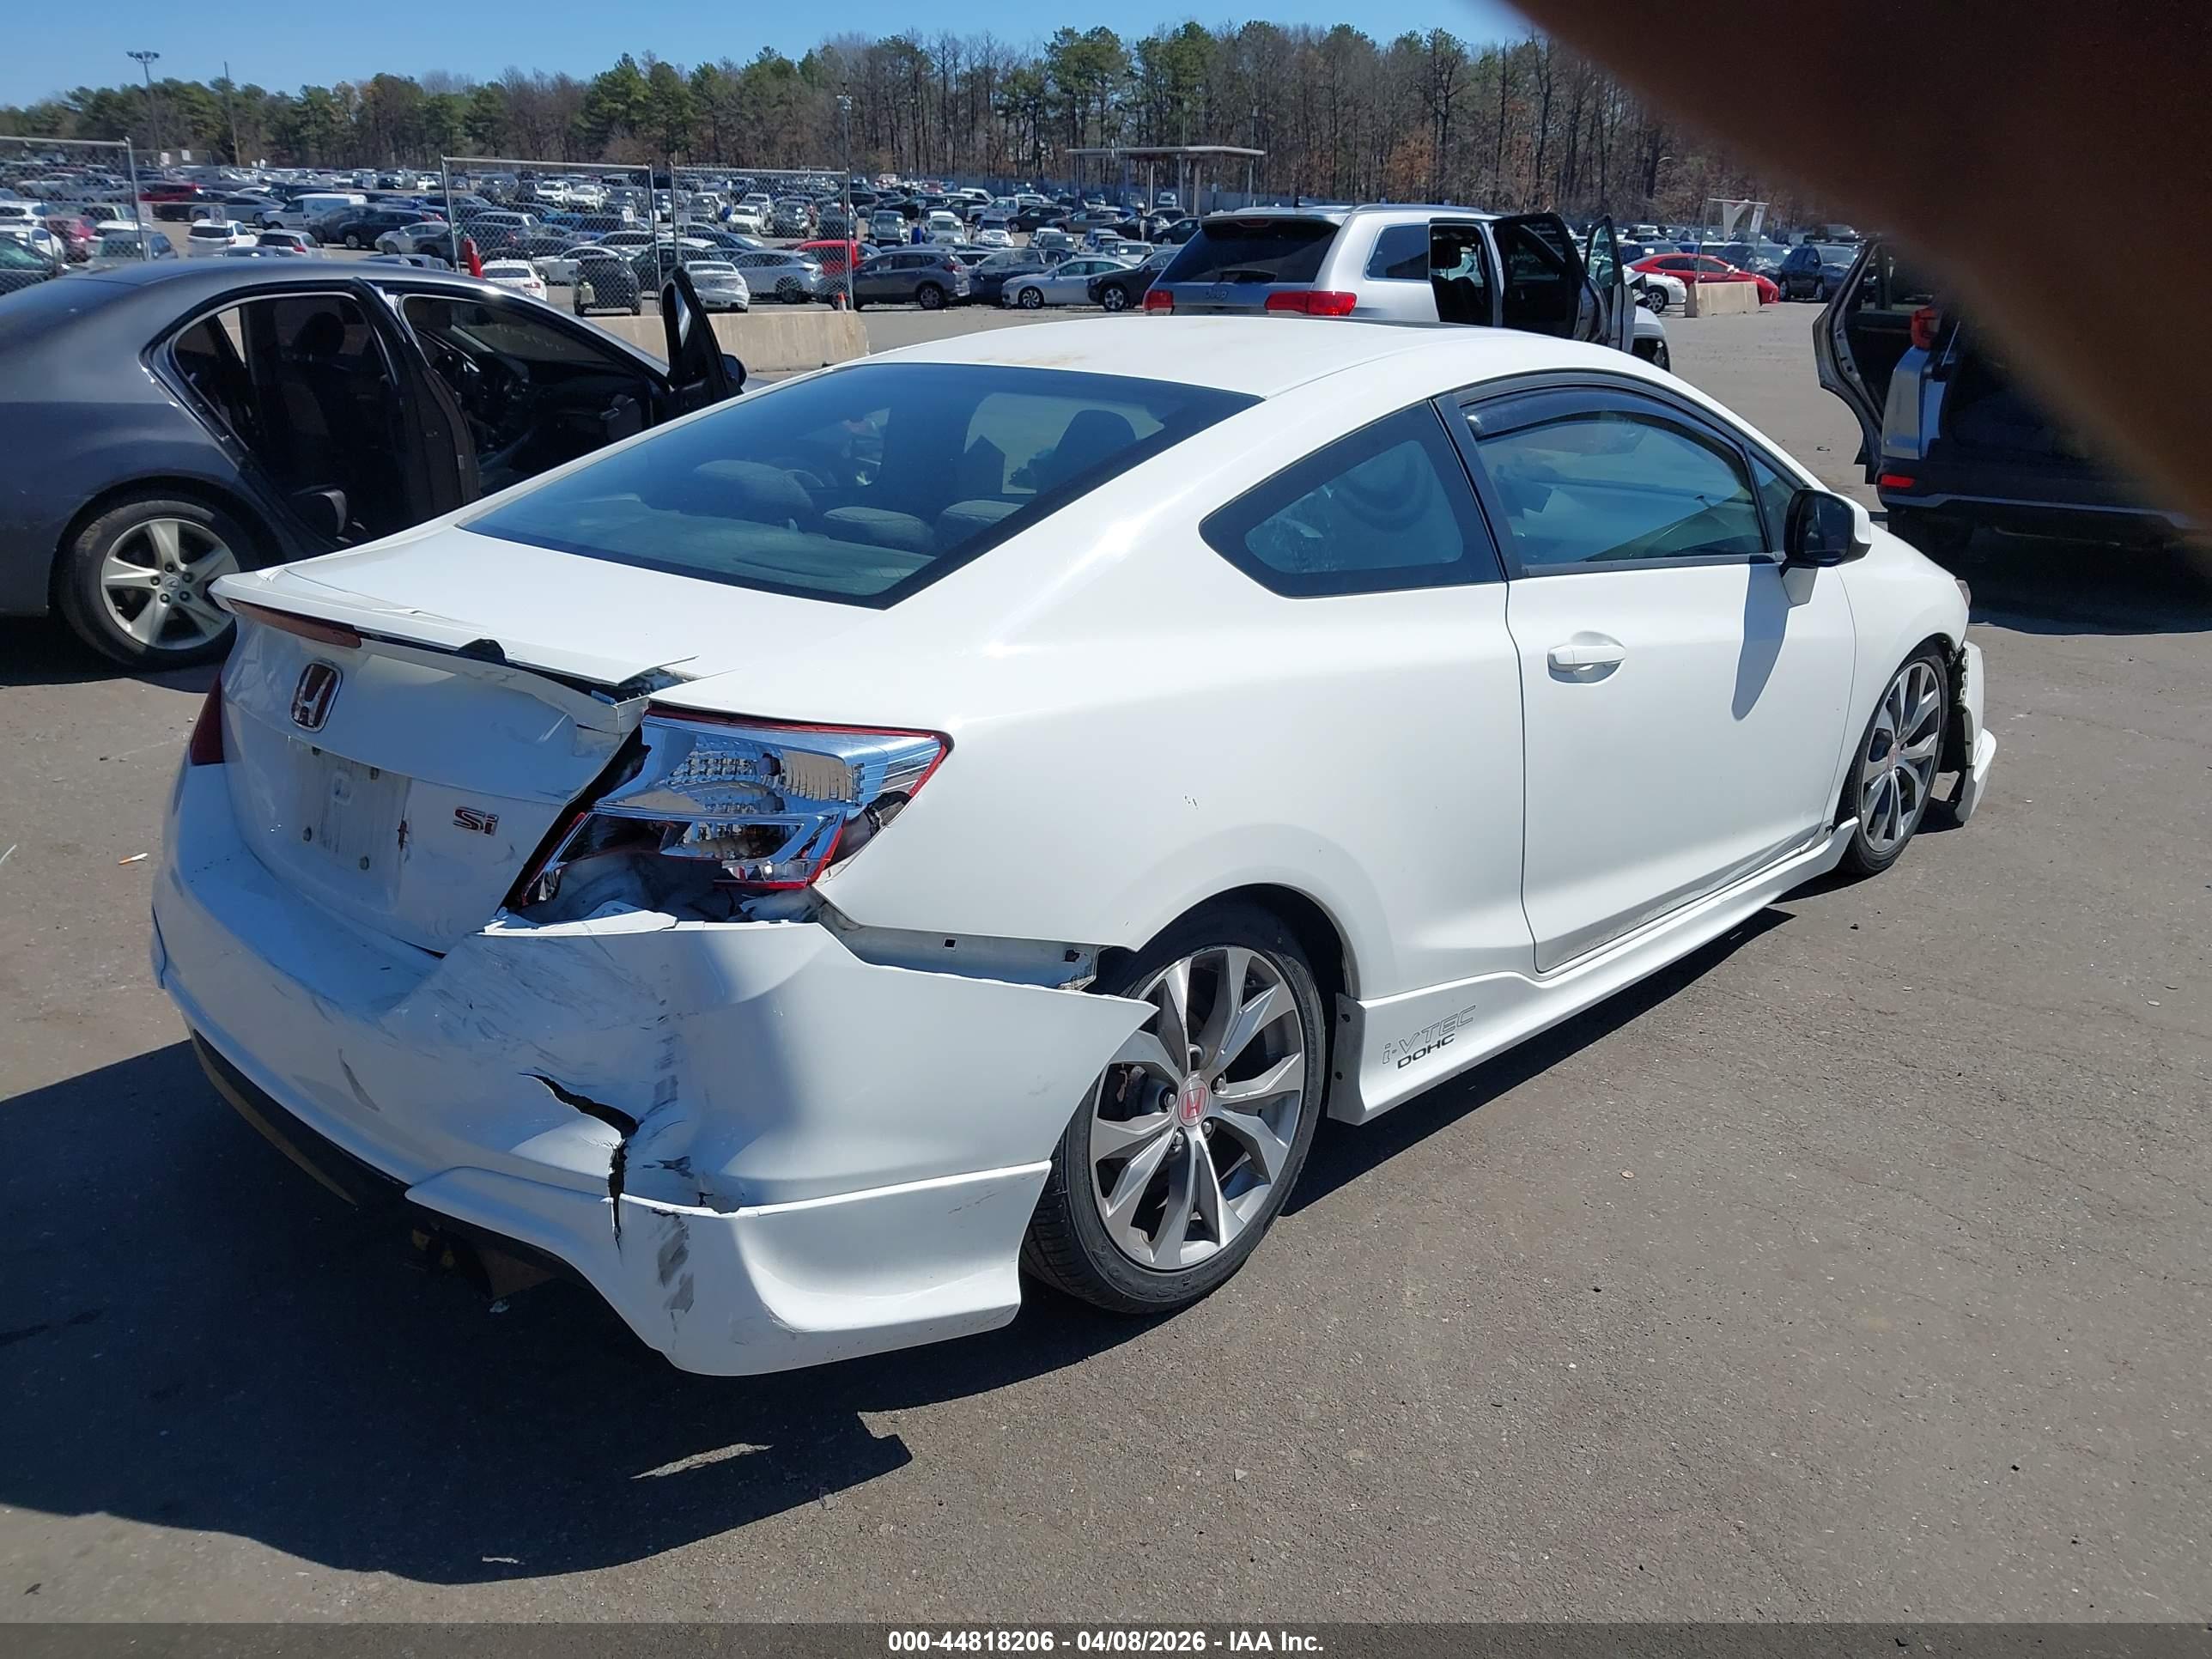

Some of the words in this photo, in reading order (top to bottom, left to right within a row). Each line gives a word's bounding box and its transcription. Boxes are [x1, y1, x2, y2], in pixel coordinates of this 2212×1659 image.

[453, 806, 499, 836] Si
[1382, 1005, 1476, 1065] i-VTEC
[1397, 1033, 1455, 1070] DOHC
